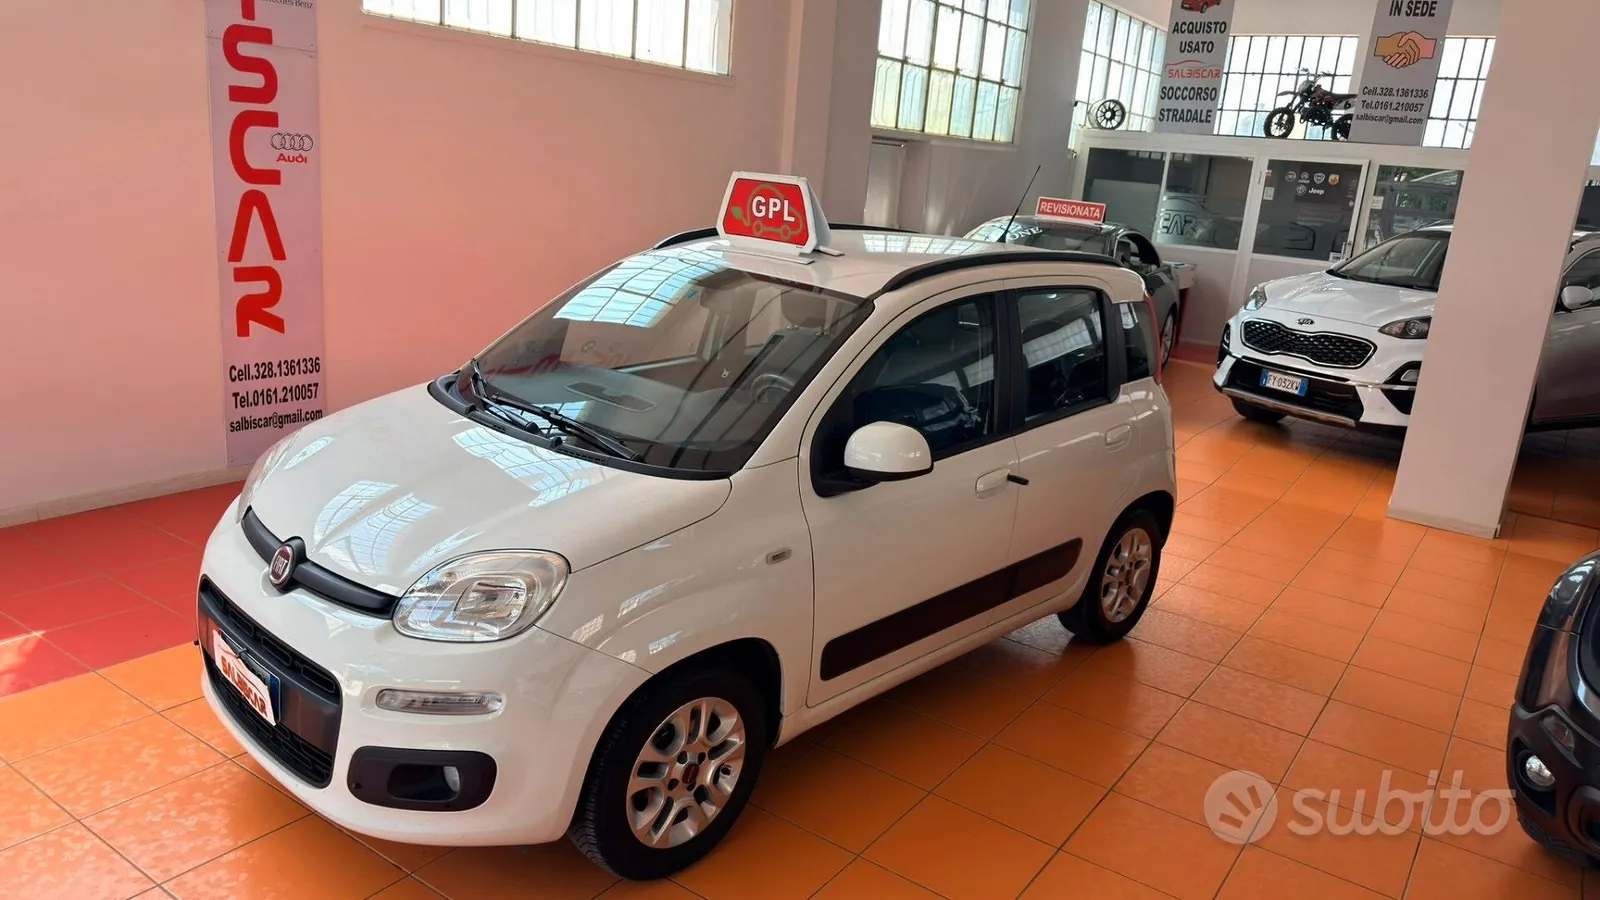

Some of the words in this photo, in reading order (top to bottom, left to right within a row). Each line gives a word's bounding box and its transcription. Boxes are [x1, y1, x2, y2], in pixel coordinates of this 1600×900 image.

[1389, 0, 1403, 16] IN
[1405, 1, 1437, 17] SEDE
[1172, 21, 1227, 34] ACQUISTO
[1180, 41, 1214, 53] USATO
[1168, 68, 1221, 79] SALBISCAR
[1160, 86, 1217, 101] SOCCORSO
[1362, 86, 1429, 98] Cell.328.1361336
[1361, 100, 1424, 112] Tel.0161.210057
[1158, 108, 1212, 123] STRADALE
[1355, 114, 1424, 124] salbiscar@gmail.com
[276, 153, 308, 164] Audi
[222, 0, 287, 338] SCAR
[1308, 187, 1325, 195] Jeep
[751, 195, 796, 222] GPL
[1039, 201, 1101, 219] REVISIONATA
[229, 356, 321, 383] Cell.328.1361336
[232, 382, 320, 410] Tel.0161.210057
[229, 408, 323, 433] salbiscar@gmail.com
[272, 554, 288, 576] FIAT
